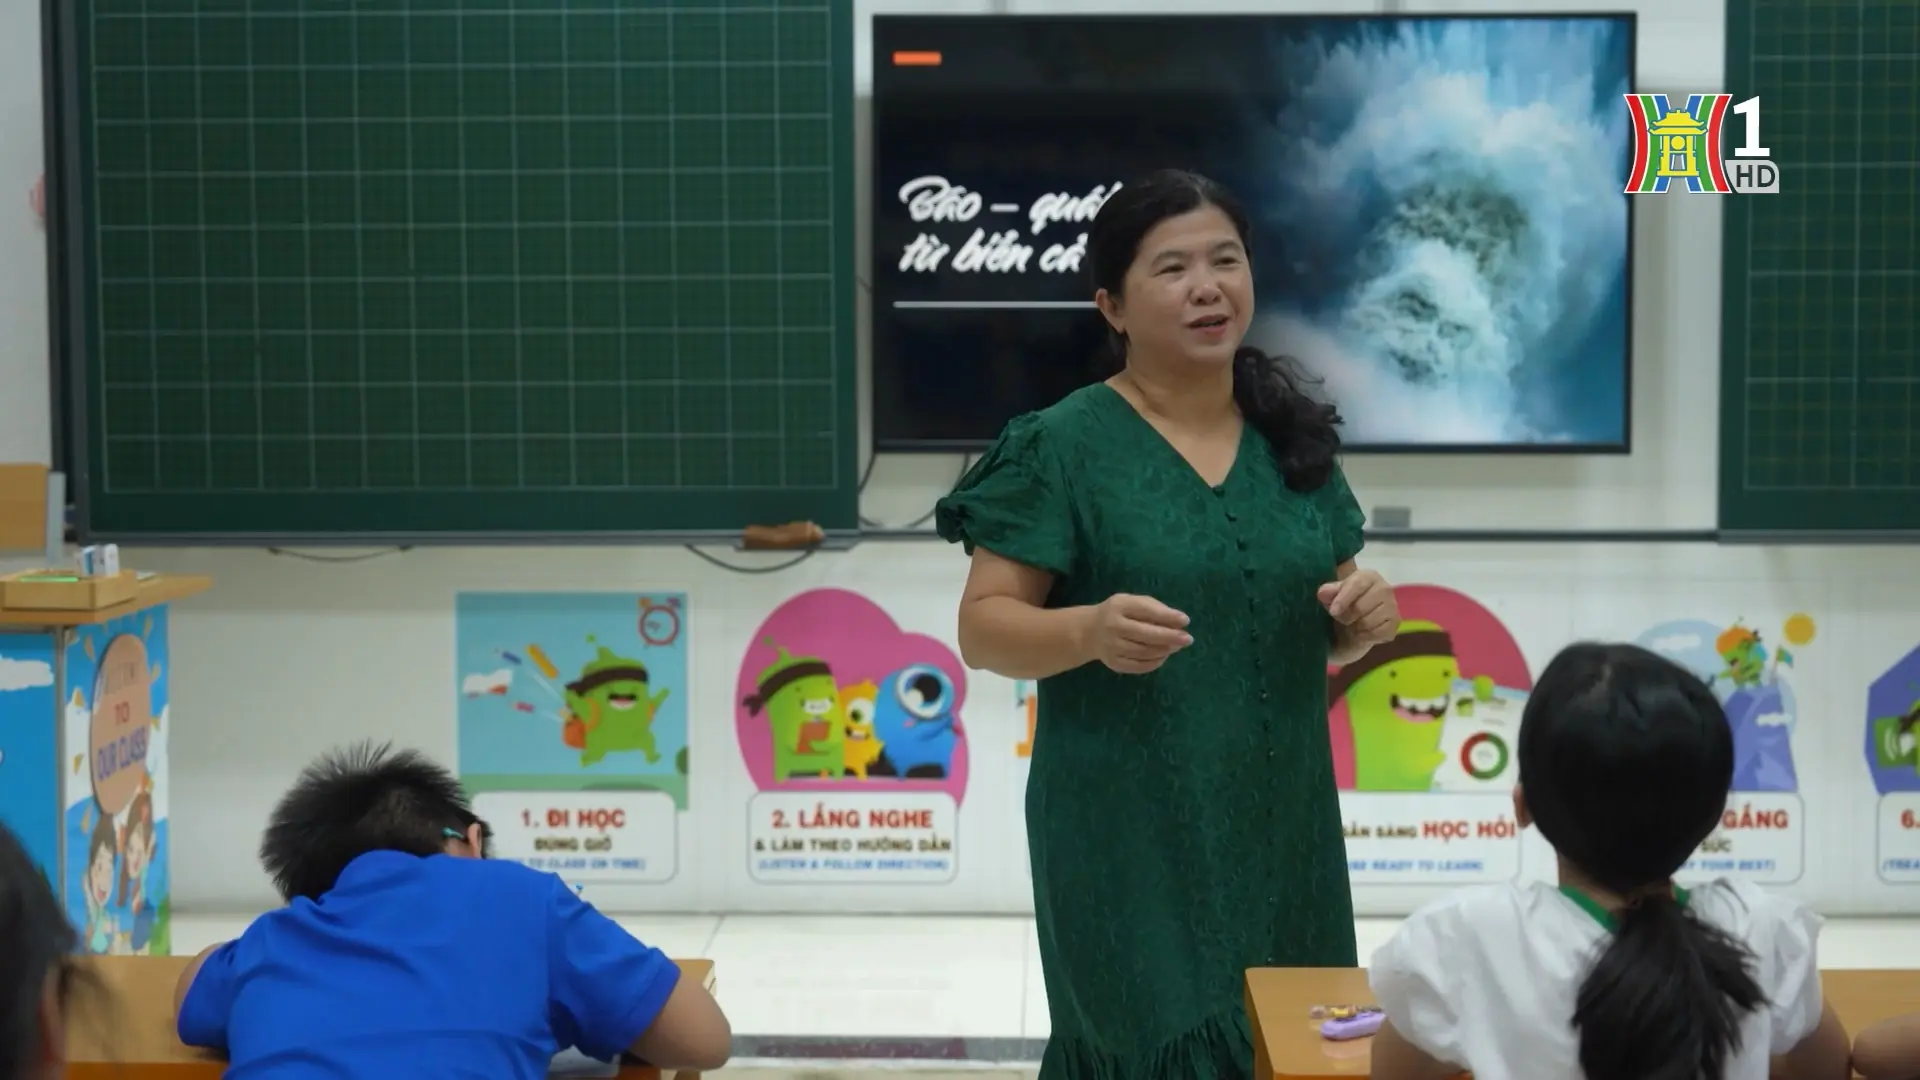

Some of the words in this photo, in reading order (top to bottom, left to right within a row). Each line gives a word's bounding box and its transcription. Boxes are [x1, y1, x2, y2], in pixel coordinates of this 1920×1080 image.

[899, 175, 983, 222] Bão
[521, 809, 540, 828] 1.
[546, 808, 570, 828] ĐI
[577, 808, 626, 833] HỌC
[771, 809, 791, 828] 2.
[798, 802, 861, 828] LẮNG
[868, 809, 934, 828] NGHE
[1722, 804, 1789, 828] GẮNG
[1422, 820, 1469, 843] HỌC
[1476, 814, 1516, 838] HỎI
[810, 838, 853, 851] THEO
